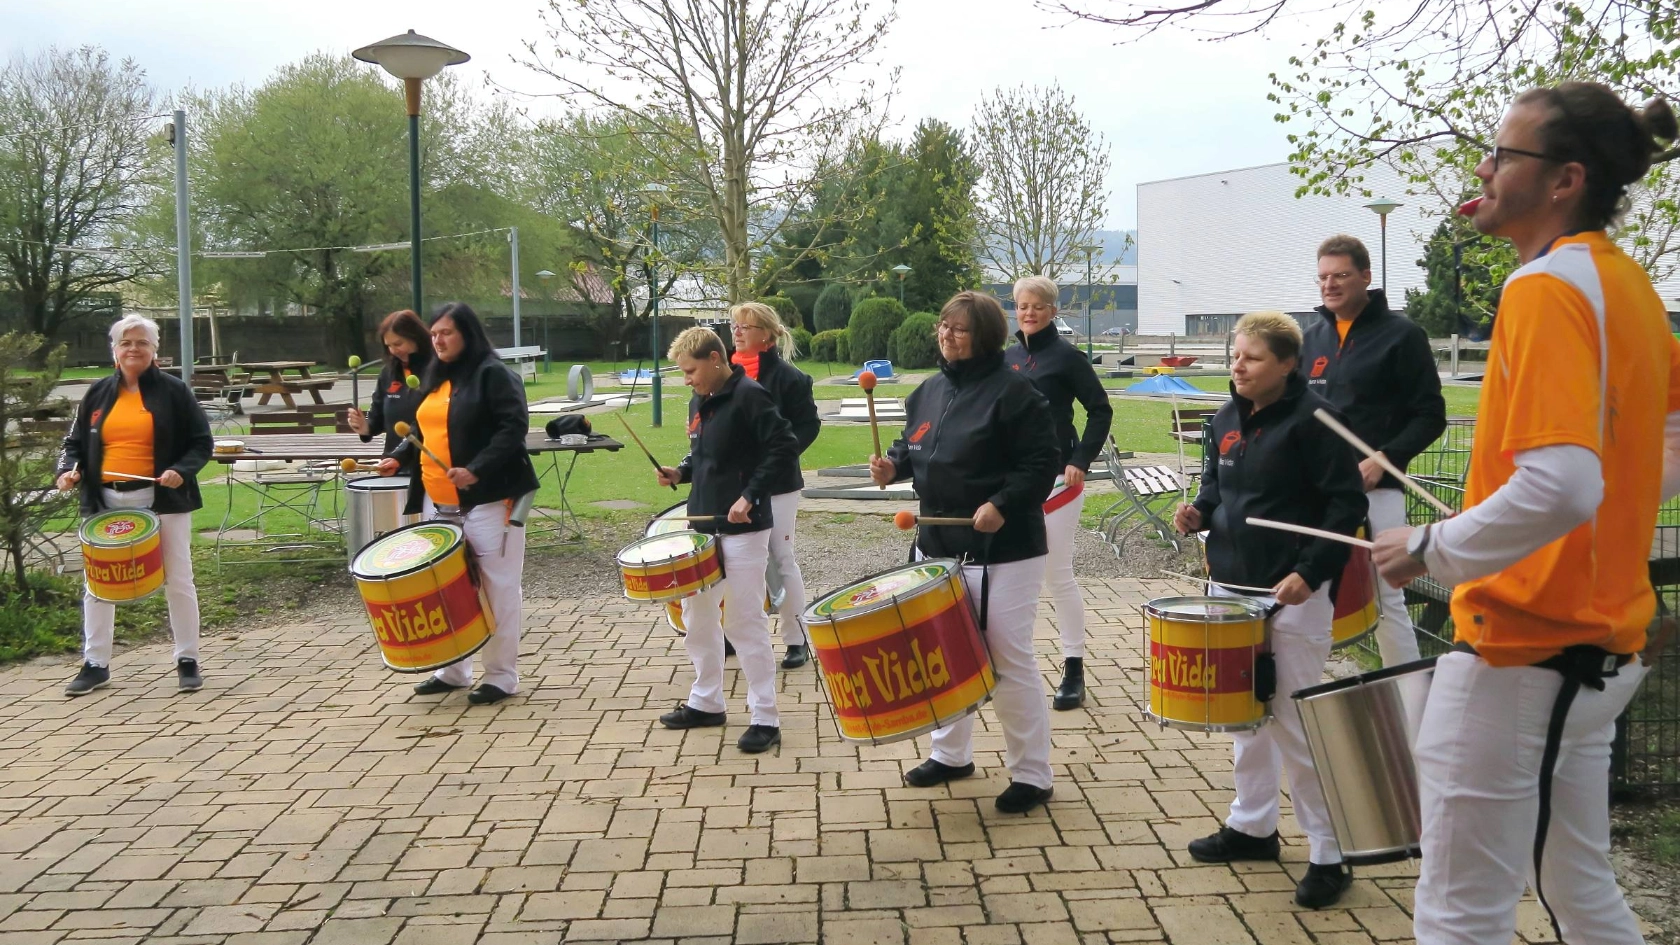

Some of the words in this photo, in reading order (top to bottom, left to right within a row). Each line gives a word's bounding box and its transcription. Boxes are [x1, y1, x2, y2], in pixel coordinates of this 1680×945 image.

[110, 562, 146, 582] Vida
[381, 601, 449, 642] Vida
[826, 669, 873, 710] ura
[862, 637, 951, 703] Vida
[1167, 649, 1217, 690] Vida
